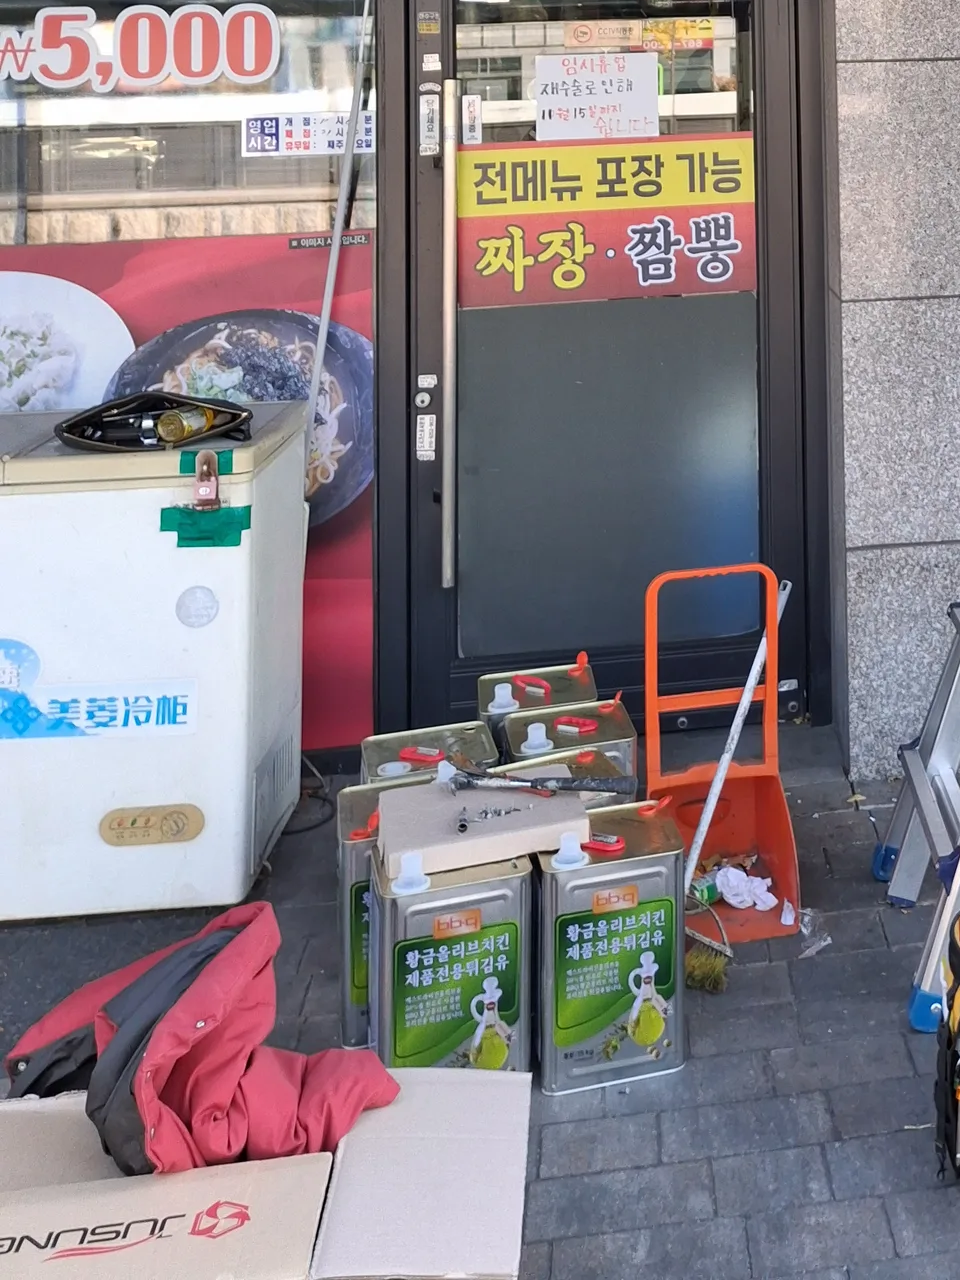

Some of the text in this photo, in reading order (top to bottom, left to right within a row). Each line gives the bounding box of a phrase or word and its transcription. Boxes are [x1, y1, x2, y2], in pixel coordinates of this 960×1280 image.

[561, 55, 627, 76] 임시휴업
[601, 77, 634, 95] 인해
[248, 119, 277, 135] 영업
[248, 136, 277, 151] 시간
[355, 138, 373, 149] 요일
[473, 150, 743, 207] 전메뉴 포장 가능
[299, 237, 325, 248] 이미지
[475, 212, 742, 294] 짜장 짬뽕
[46, 694, 189, 731] 美菱冷柜
[566, 908, 666, 943] 황금올리브치킨
[404, 932, 510, 969] 황금올리브치킨
[565, 930, 667, 962] 제품전용튀김유
[403, 953, 510, 989] 제품전용튀김유
